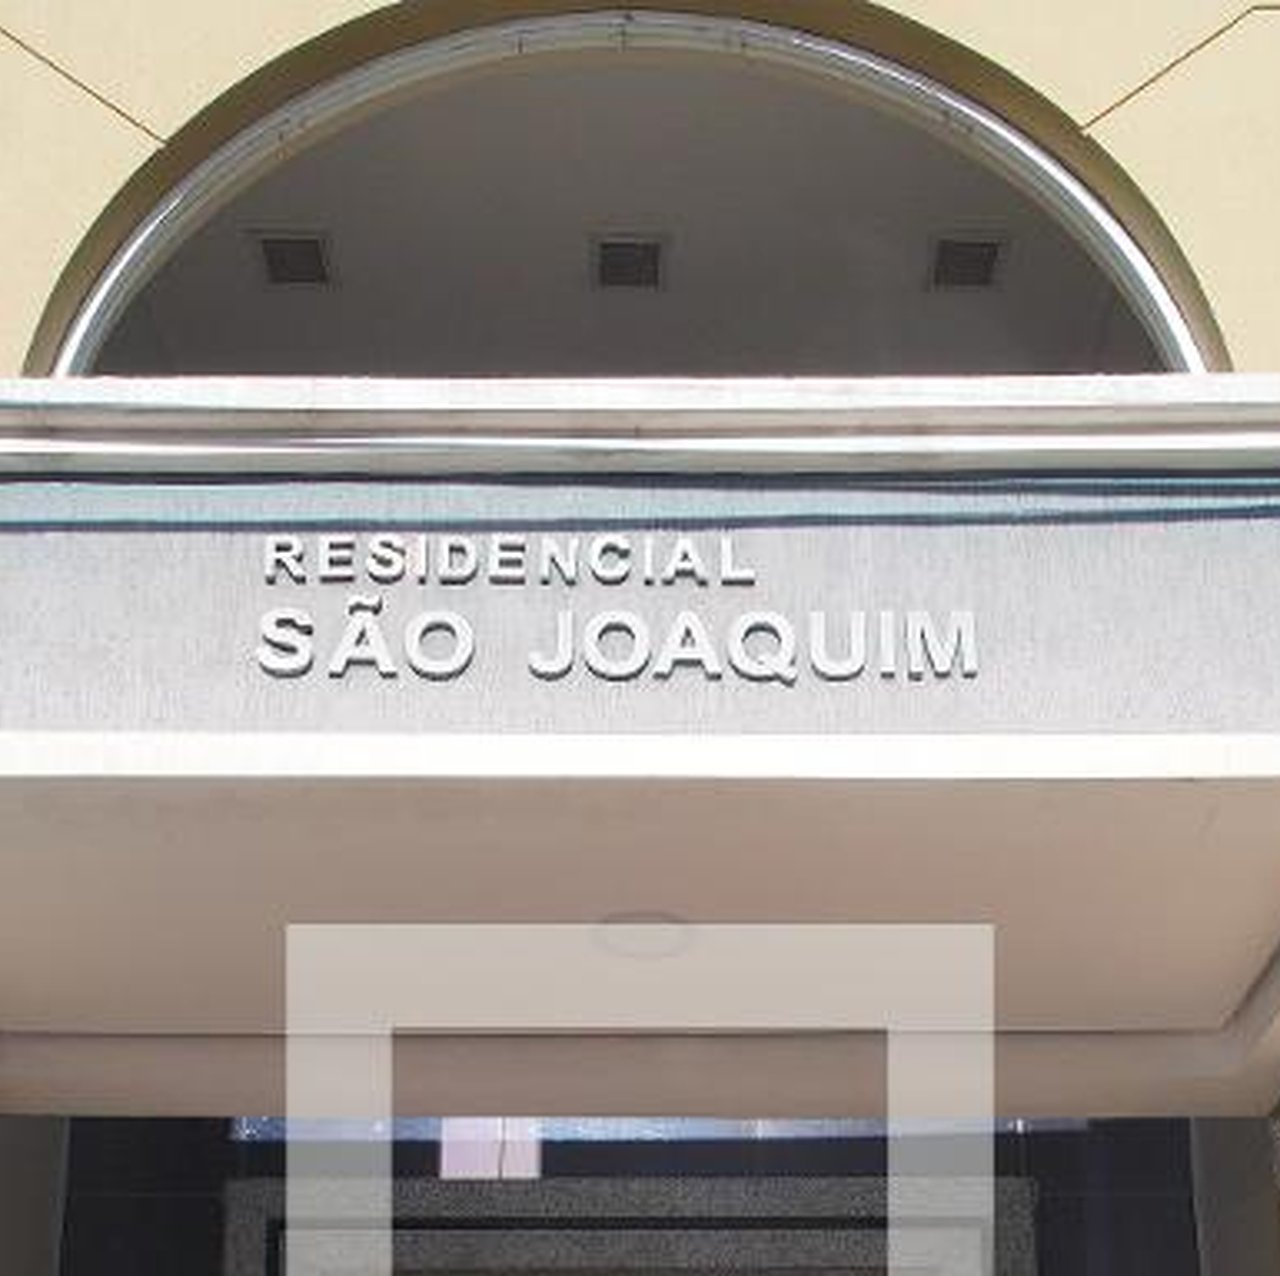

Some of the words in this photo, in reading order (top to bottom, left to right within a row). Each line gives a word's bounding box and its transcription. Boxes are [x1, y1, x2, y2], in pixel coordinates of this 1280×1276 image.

[263, 533, 757, 586] RESIDENCIAL
[254, 596, 477, 682] SÃO
[527, 608, 980, 688] JOAQUIM
